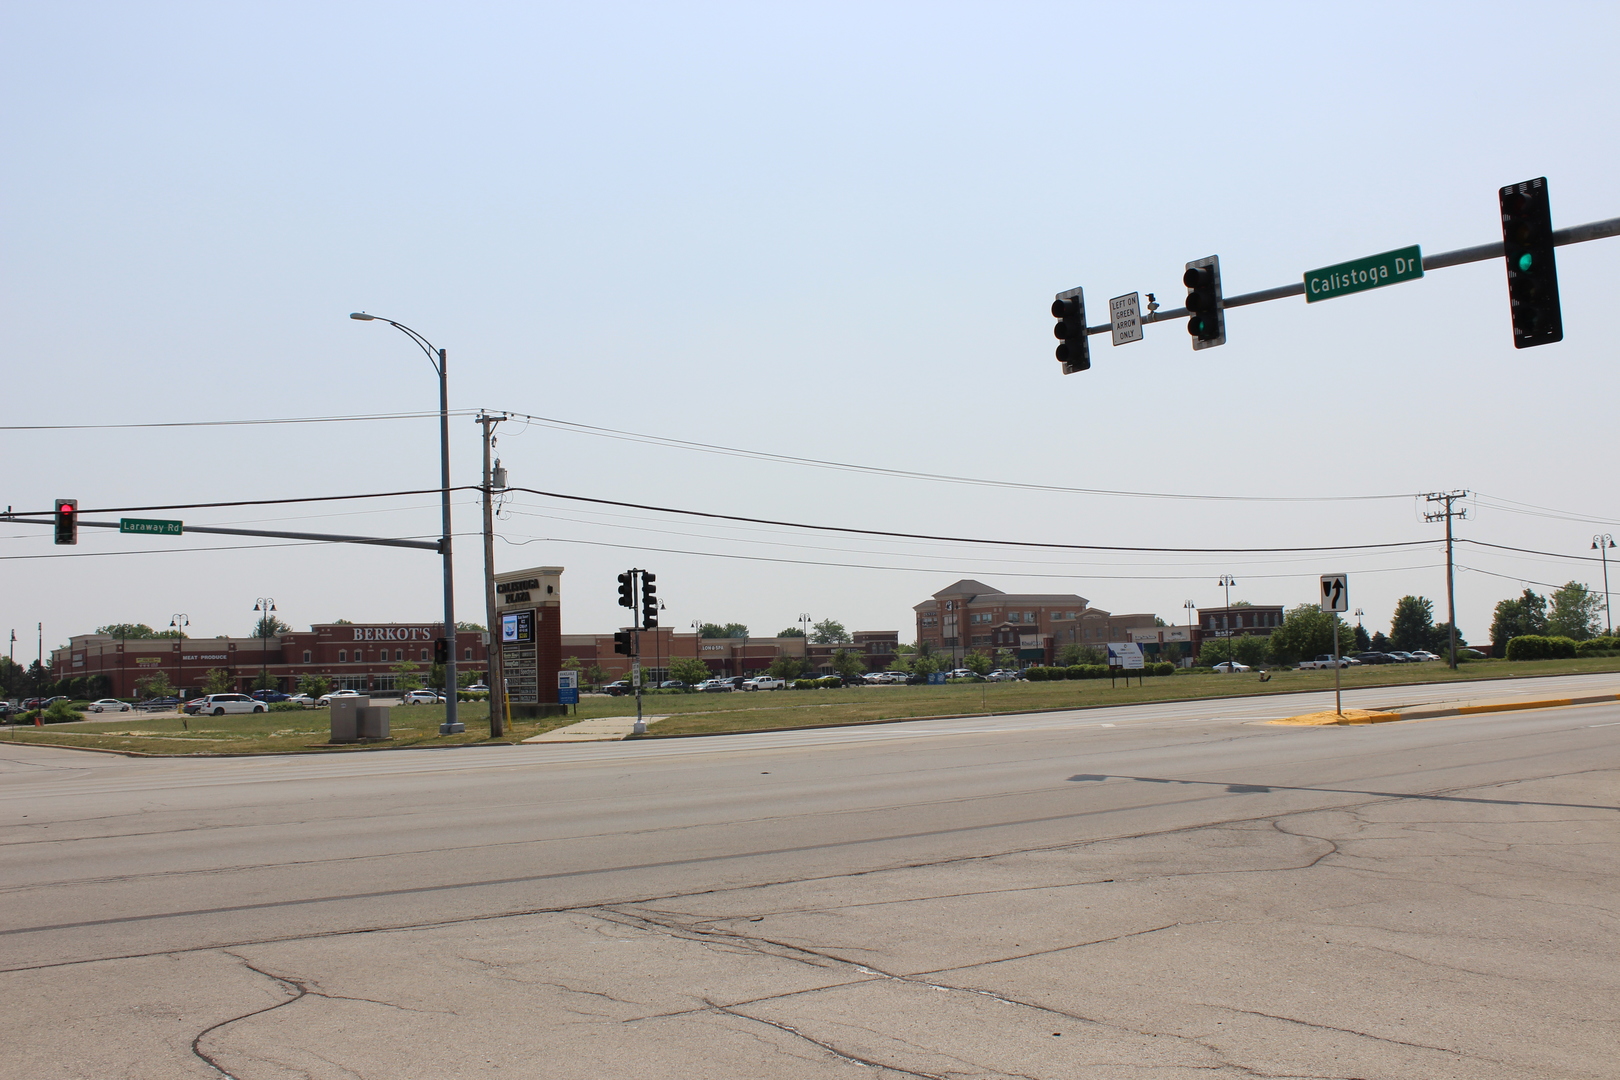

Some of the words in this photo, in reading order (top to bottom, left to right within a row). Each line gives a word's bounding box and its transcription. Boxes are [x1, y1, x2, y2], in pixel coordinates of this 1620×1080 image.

[1311, 265, 1388, 294] Calistoga
[1395, 258, 1414, 275] Dr
[1112, 300, 1126, 310] LEFT
[1127, 296, 1137, 306] ON
[1116, 308, 1135, 319] GREEN
[1116, 319, 1136, 330] ARROW
[1119, 330, 1135, 340] ONLY
[123, 521, 164, 533] Laraway
[167, 523, 180, 532] Rd
[496, 579, 540, 594] CALISTOGA
[505, 591, 532, 604] PLAZA
[352, 627, 431, 641] BERKOT'S
